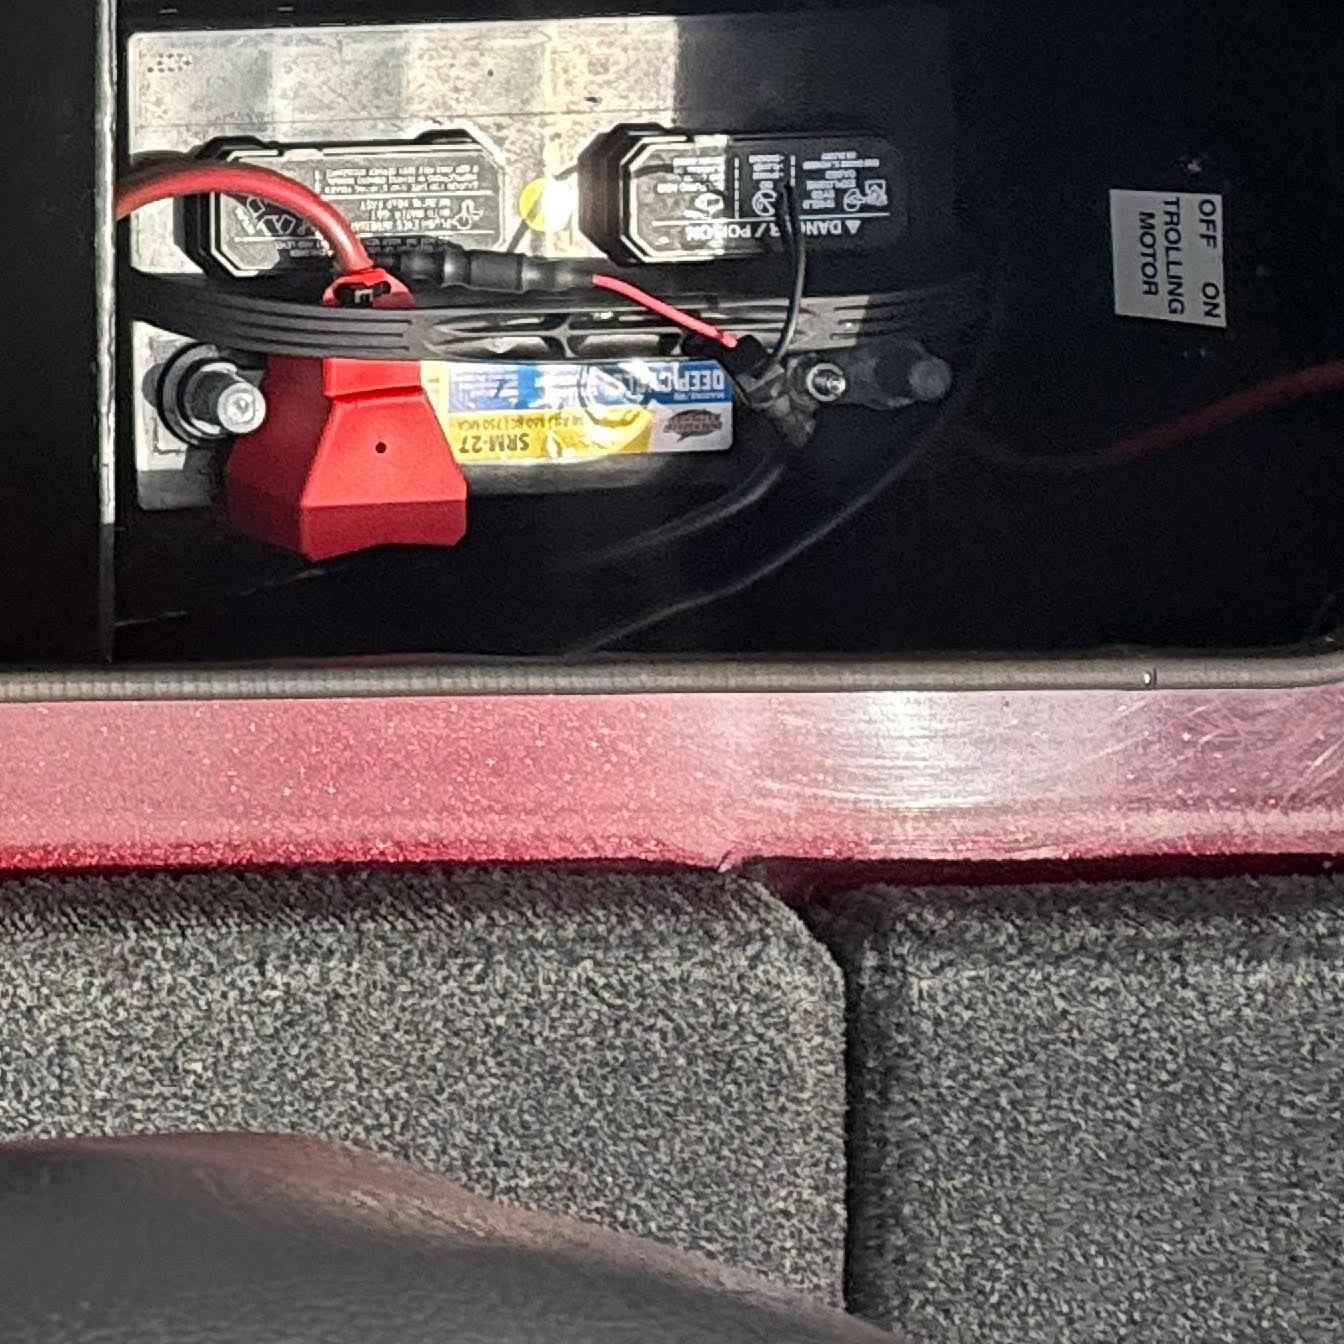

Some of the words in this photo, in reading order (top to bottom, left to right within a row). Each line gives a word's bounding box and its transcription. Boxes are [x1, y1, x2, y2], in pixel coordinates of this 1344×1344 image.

[684, 222, 753, 242] POISON
[1198, 199, 1218, 248] OFF
[1138, 212, 1160, 296] MOTOR
[1162, 197, 1185, 315] TROLLING
[1201, 282, 1221, 318] ON
[676, 369, 726, 392] DEEP
[458, 433, 530, 455] SRM-27
